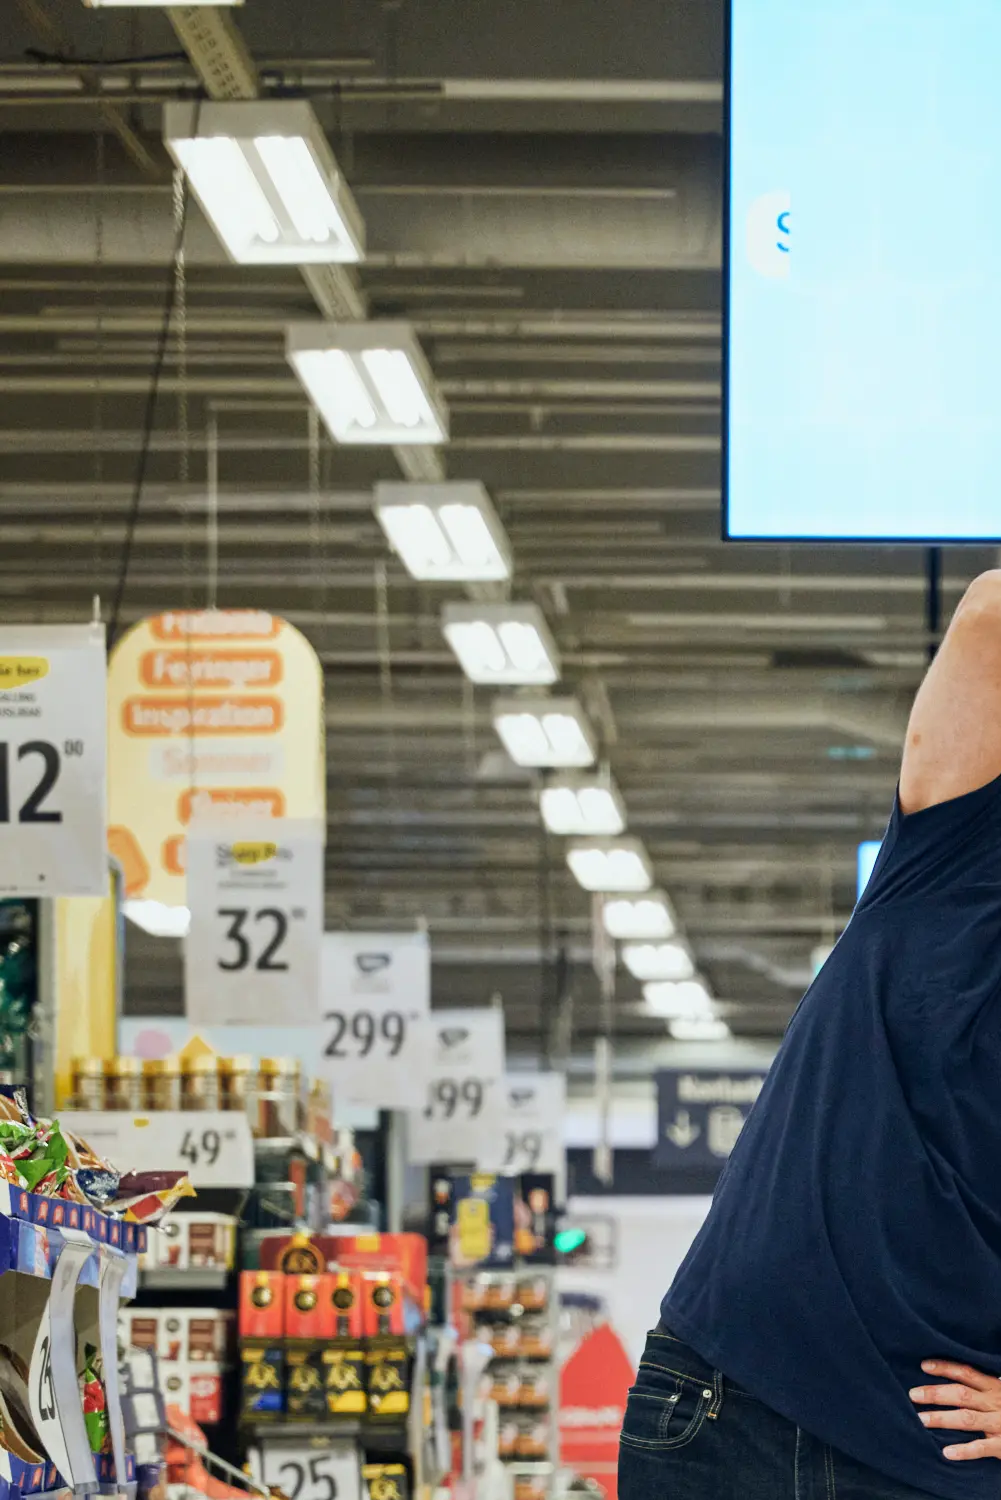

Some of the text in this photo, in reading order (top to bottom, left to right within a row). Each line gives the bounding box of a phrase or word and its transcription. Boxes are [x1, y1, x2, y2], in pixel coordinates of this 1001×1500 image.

[132, 701, 274, 734] Inspiration
[217, 907, 290, 972] 32
[322, 1010, 406, 1059] 299
[178, 1130, 221, 1167] 49
